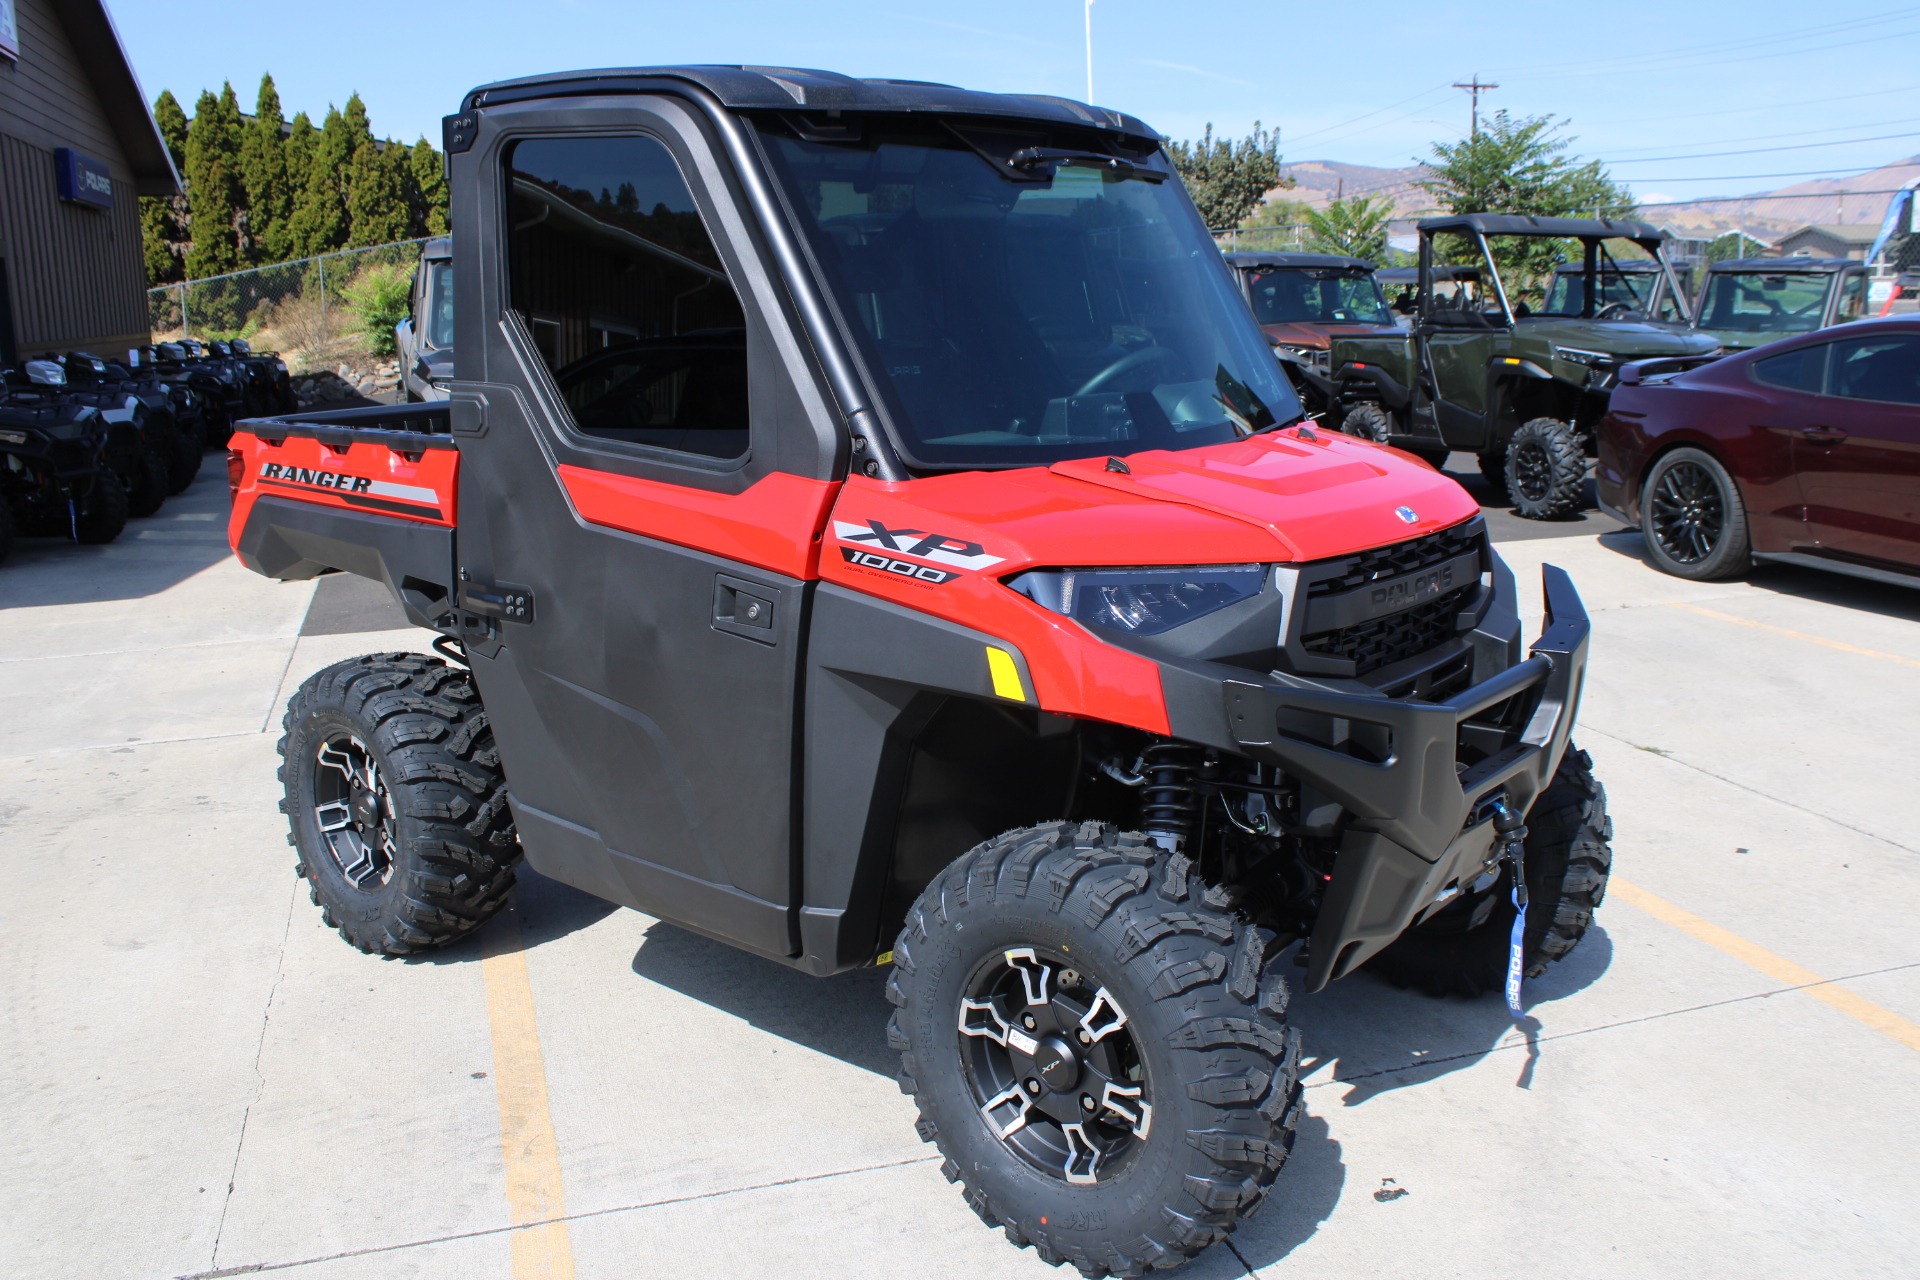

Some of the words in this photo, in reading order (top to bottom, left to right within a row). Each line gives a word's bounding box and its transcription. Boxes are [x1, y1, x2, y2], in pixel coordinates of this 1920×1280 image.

[264, 462, 373, 494] RANGER
[842, 519, 986, 557] XP
[844, 565, 866, 575] DUAL
[867, 571, 914, 586] OVERHEAD
[914, 581, 935, 591] CAM
[850, 551, 947, 583] 1000
[1371, 565, 1454, 606] POLARIS
[1508, 944, 1521, 1011] POLARIS
[1041, 1060, 1061, 1075] XP
